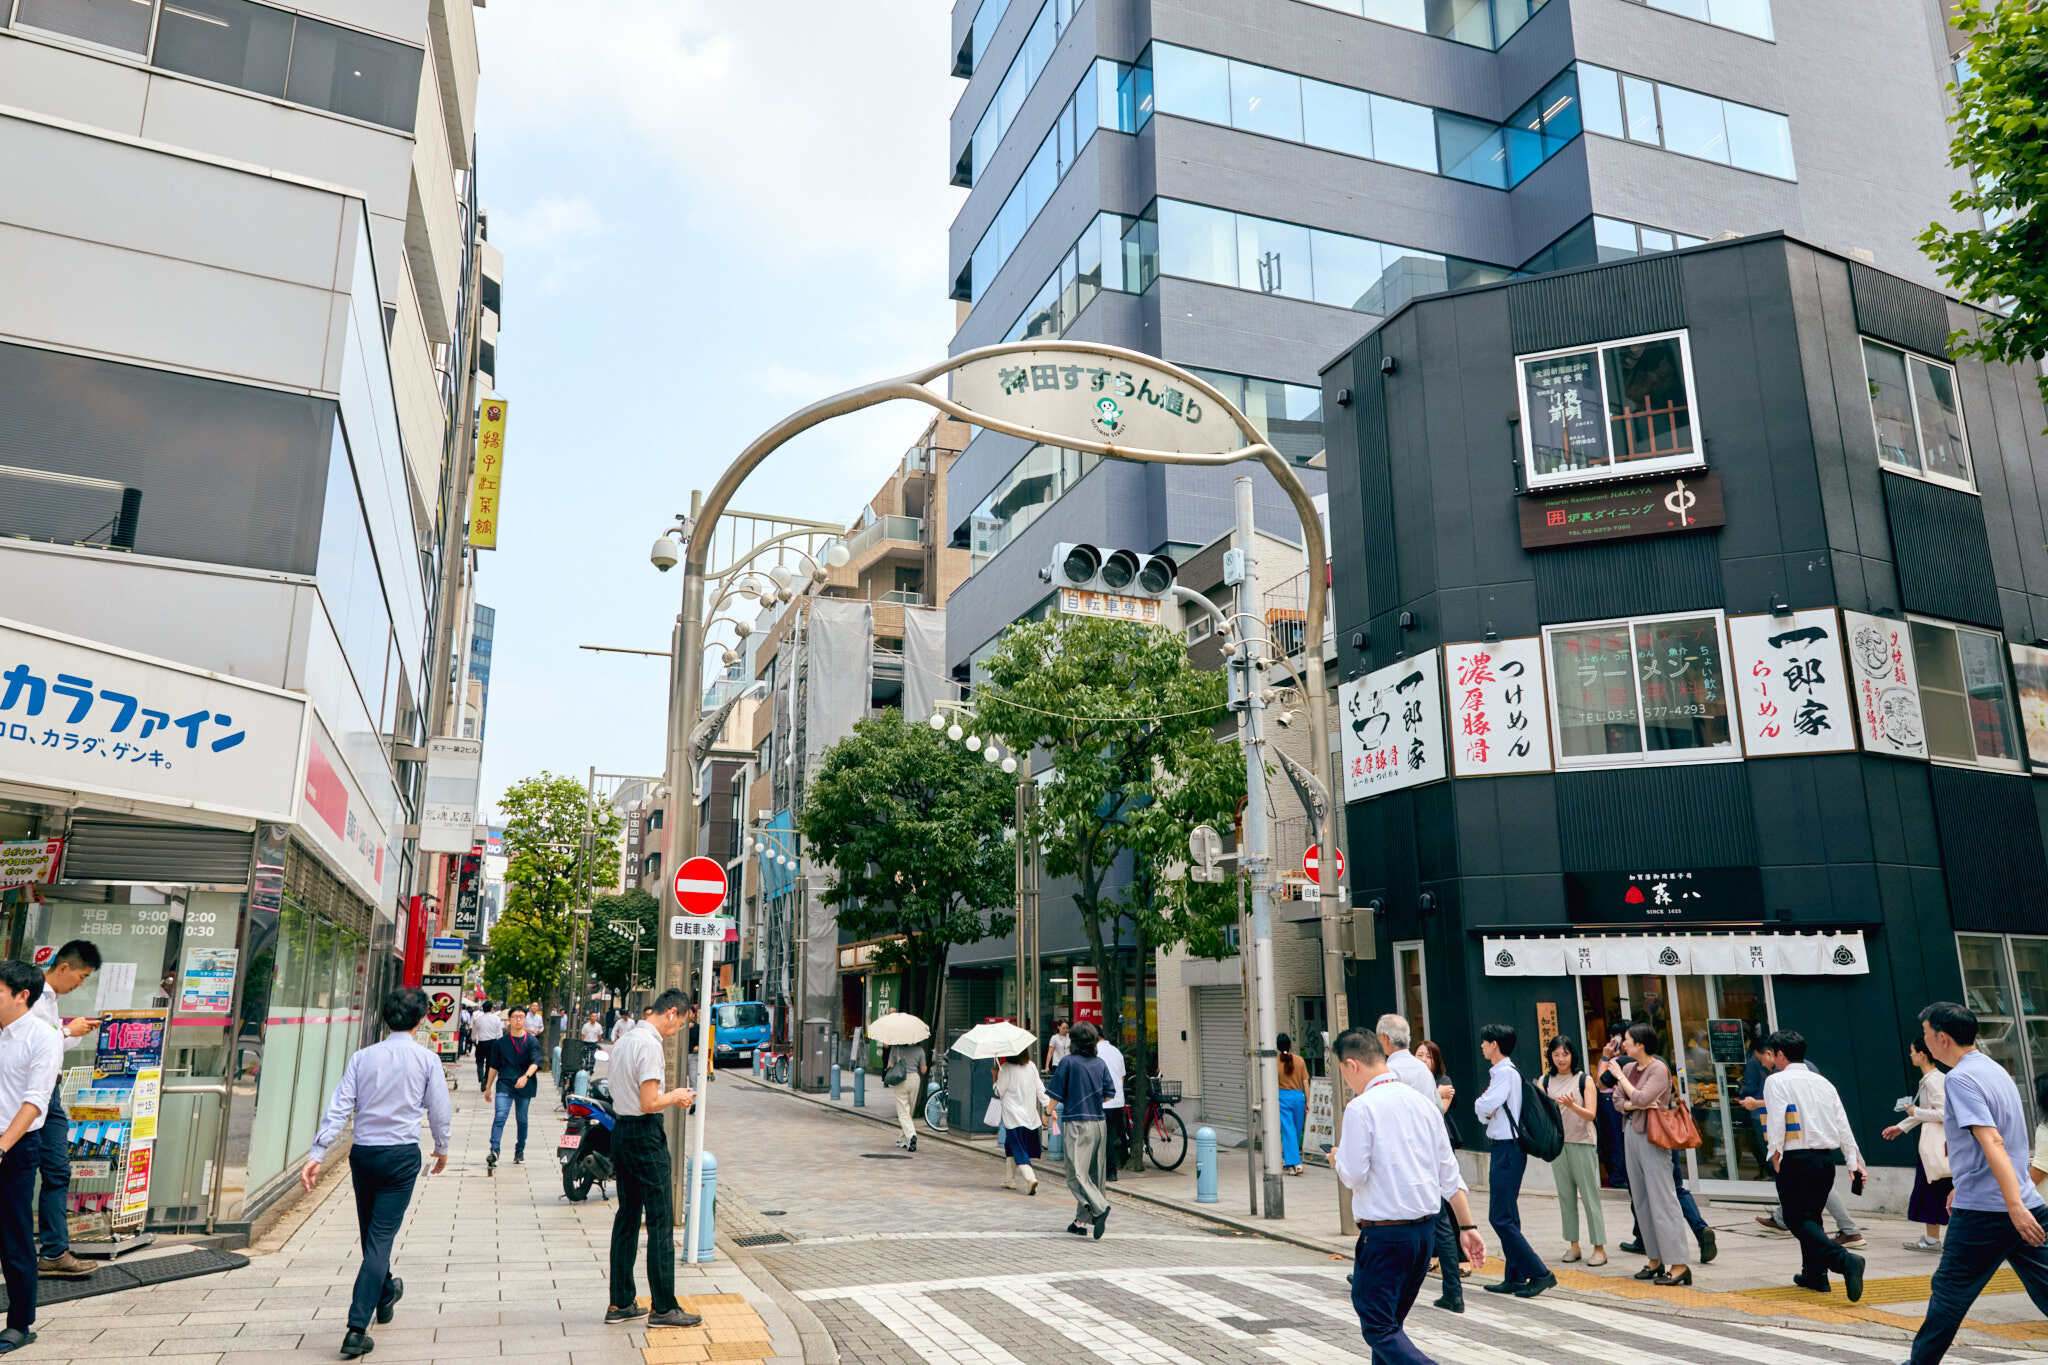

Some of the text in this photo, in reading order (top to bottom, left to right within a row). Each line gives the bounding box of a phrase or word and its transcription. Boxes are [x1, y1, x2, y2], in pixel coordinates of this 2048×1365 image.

[1577, 659, 1690, 687] ラーメン
[1700, 646, 1718, 702] ちょい飲み
[1753, 660, 1781, 738] らーめん
[1768, 626, 1832, 737] 一郎家
[0, 664, 245, 753] カラファイン
[1396, 671, 1426, 771] 一郎家
[1457, 652, 1496, 763] 濃厚豚骨
[1500, 661, 1531, 757] つけめん
[131, 924, 166, 935] 10:00
[138, 910, 168, 922] 9:00
[457, 911, 476, 923] 24H
[675, 922, 720, 936] 自転車を除く
